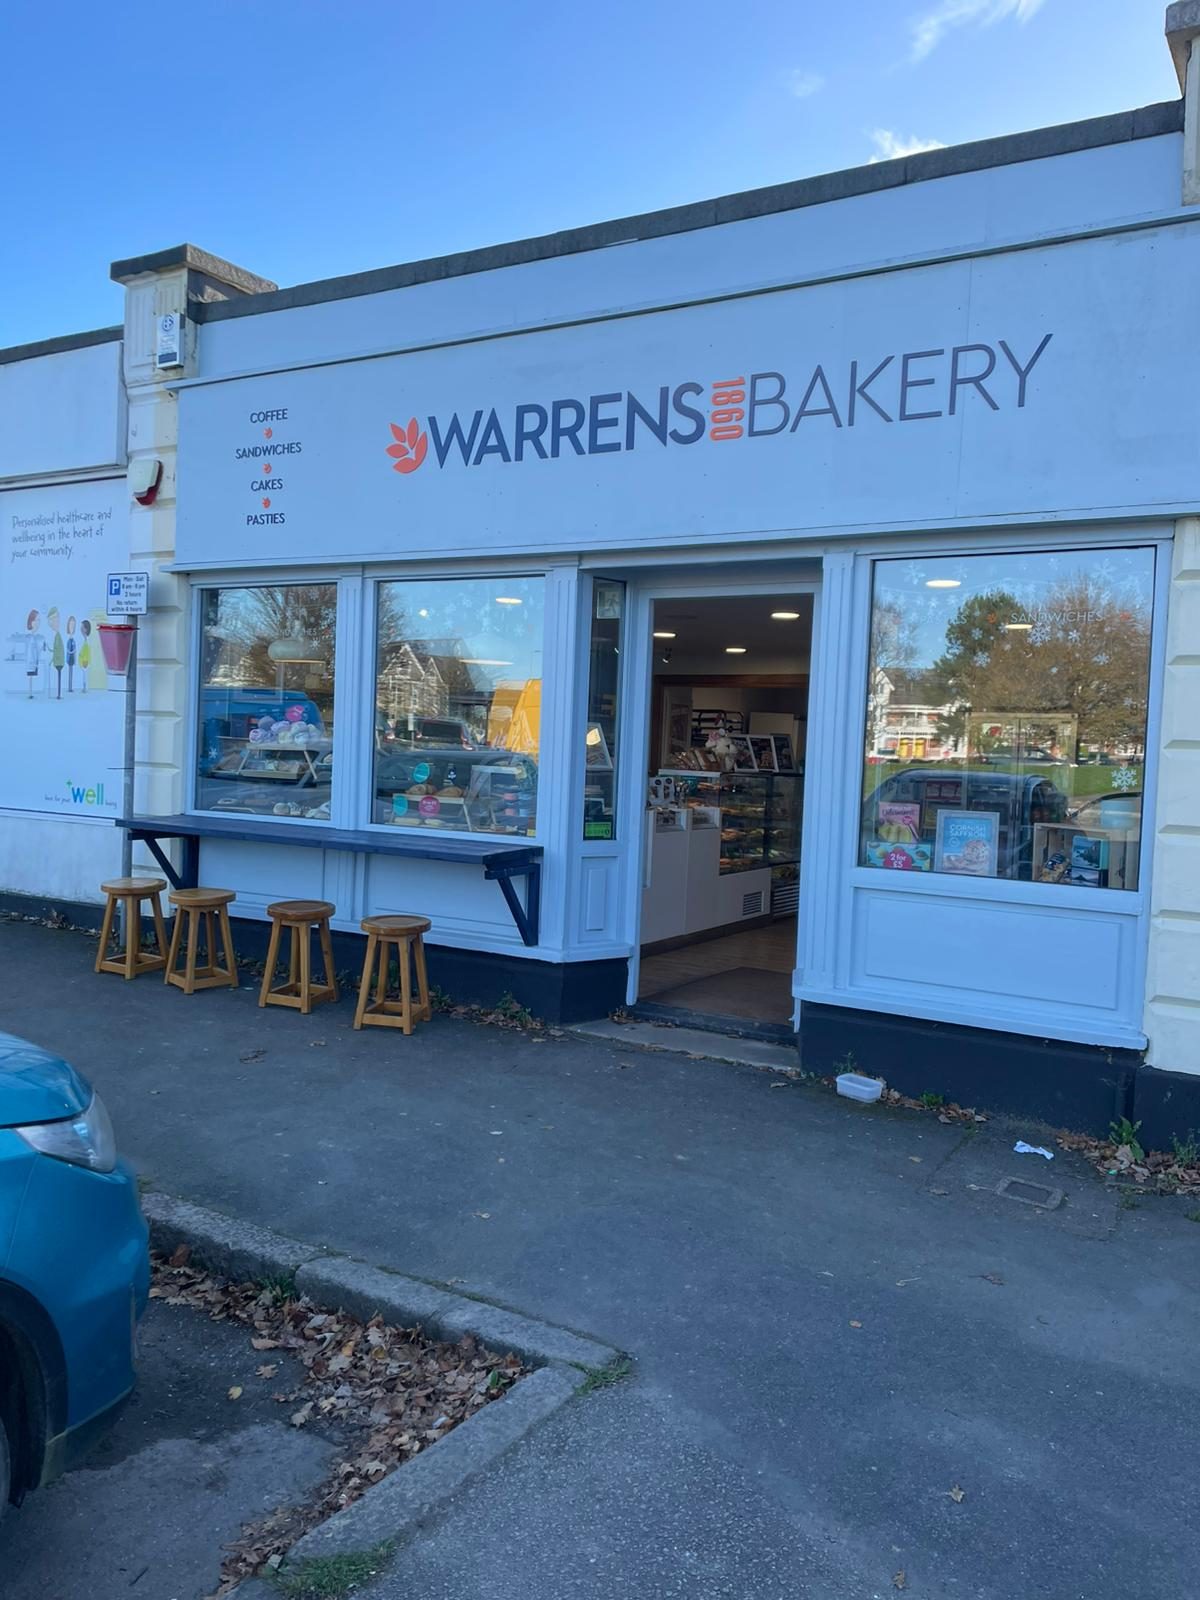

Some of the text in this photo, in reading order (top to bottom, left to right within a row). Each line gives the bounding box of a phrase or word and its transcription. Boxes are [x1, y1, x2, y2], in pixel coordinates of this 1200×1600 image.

[428, 334, 1053, 470] WARRENS 1860 BAKERY
[250, 408, 288, 424] COFFEE
[236, 442, 302, 459] SANDWICHES
[250, 478, 284, 492] CAKES
[58, 508, 95, 524] healthcare
[98, 507, 112, 520] and
[246, 512, 286, 526] PASTIES
[12, 524, 104, 544] wellbeing in the heart of
[10, 550, 28, 563] your
[1010, 610, 1104, 624] SANDWICHES
[72, 783, 104, 805] well
[896, 853, 907, 861] for
